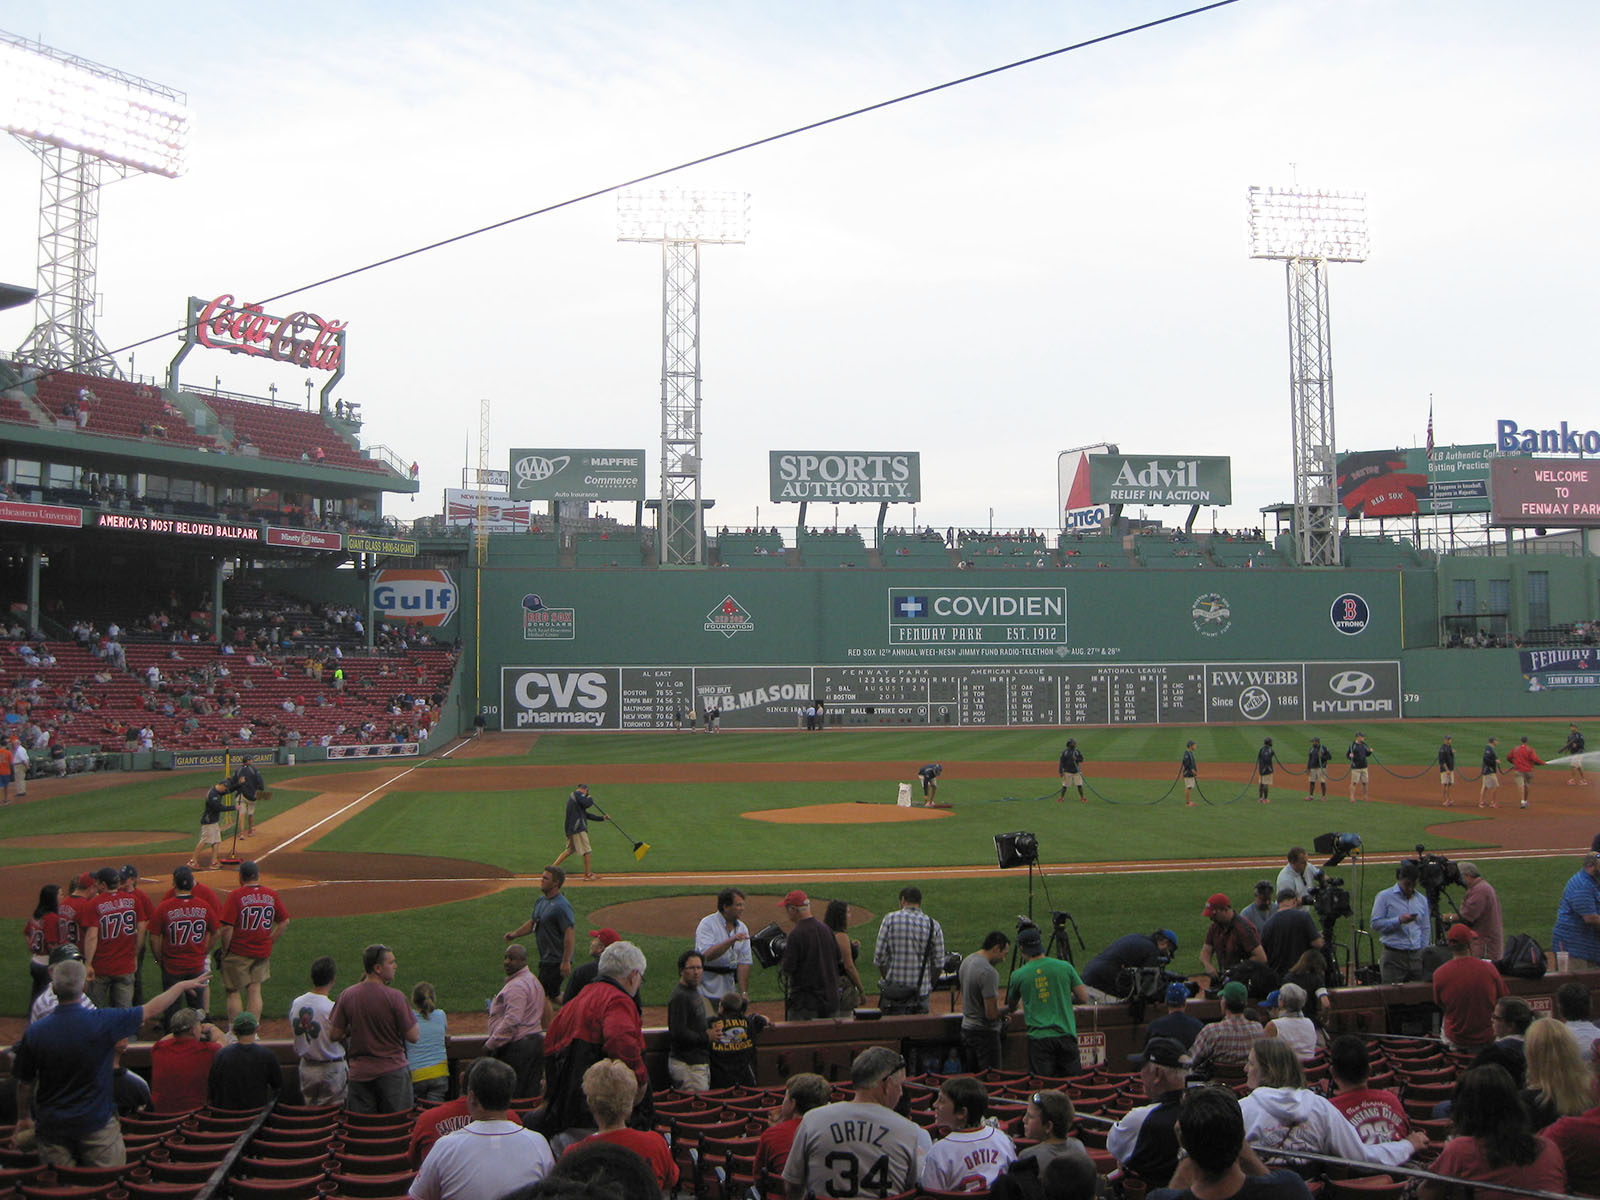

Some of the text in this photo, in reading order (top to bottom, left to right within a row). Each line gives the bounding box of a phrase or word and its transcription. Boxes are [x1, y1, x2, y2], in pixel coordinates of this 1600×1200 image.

[198, 294, 348, 371] Coca-Cola
[592, 458, 638, 466] MAPFRE
[1446, 451, 1480, 460] Authentic
[521, 458, 549, 479] AAA
[780, 455, 909, 481] SPORTS
[1112, 460, 1198, 487] Advil
[1429, 462, 1489, 472] Batting Practice
[585, 476, 638, 485] Commerce
[1535, 471, 1588, 482] WELCOME
[781, 483, 908, 497] AUTHORITY
[1111, 490, 1209, 500] RELIEF IN ACTION
[1555, 488, 1569, 498] TO
[1371, 492, 1403, 506] RED SOX
[39, 510, 78, 522] University
[1522, 504, 1568, 514] FENWAY
[1066, 508, 1104, 527] CITGO
[100, 515, 258, 539] AMERICA'S MOST BELOVED BALLPARK
[281, 533, 325, 544] Ninety Nine
[349, 539, 363, 550] GIANT
[365, 541, 382, 551] GLASS
[400, 544, 415, 554] GIANT
[374, 587, 451, 609] Gulf
[934, 596, 1062, 615] COVIDIEN
[1343, 599, 1357, 620] B
[528, 612, 571, 622] RED SOX
[900, 628, 1056, 640] FENWAY PARK EST. 1912
[892, 648, 918, 656] ANNUAL
[959, 648, 980, 656] JIMMY
[1530, 650, 1589, 670] FENWAY
[1212, 671, 1297, 686] F.W. WEBB
[515, 673, 608, 708] CVS
[1212, 697, 1233, 706] Since
[1278, 696, 1298, 705] 1866
[1404, 694, 1419, 702] 379
[483, 706, 497, 714] 310
[1313, 699, 1392, 712] HYUNDAI
[517, 709, 605, 726] pharmacy
[200, 756, 223, 764] GLASS
[98, 898, 135, 913] COLLIER
[241, 894, 275, 906] COLLIER
[168, 908, 207, 919] COLLIER
[241, 907, 275, 930] 179
[100, 910, 136, 939] 179
[168, 920, 207, 945] 179
[830, 1120, 889, 1148] ORTIZ
[964, 1149, 999, 1169] ORTIZ
[825, 1151, 892, 1198] 34
